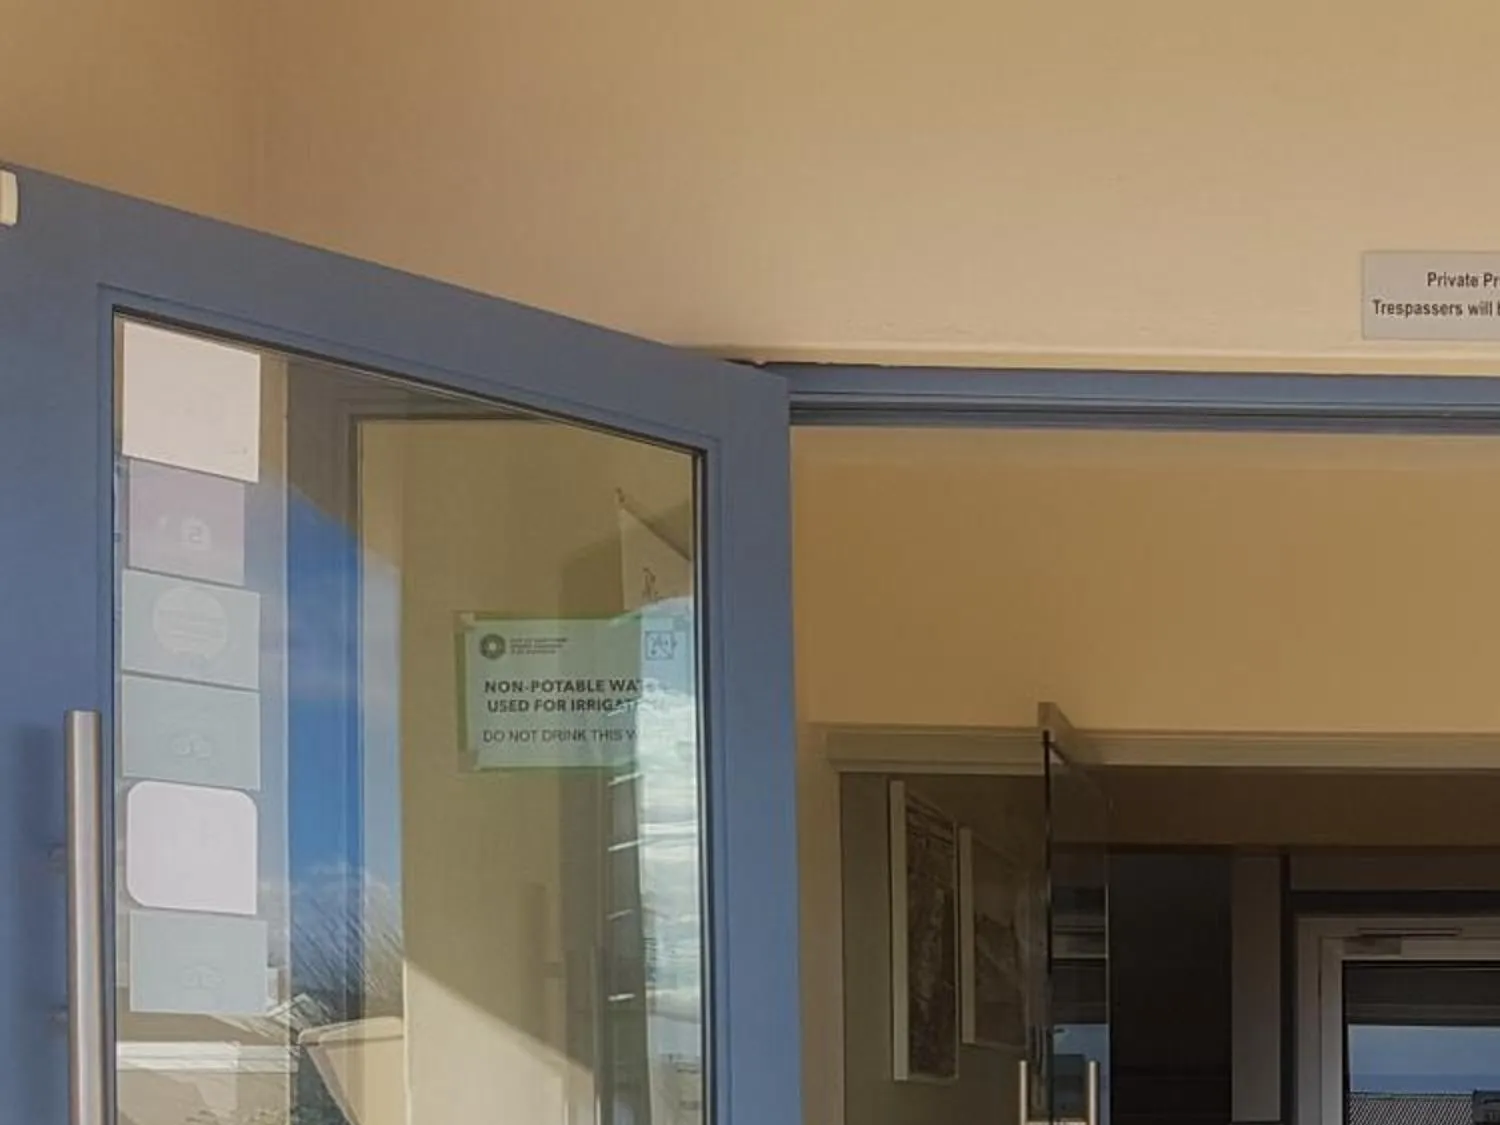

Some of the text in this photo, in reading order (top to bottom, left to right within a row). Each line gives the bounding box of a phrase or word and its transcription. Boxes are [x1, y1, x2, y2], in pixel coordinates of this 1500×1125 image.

[1426, 272, 1479, 288] Private
[1373, 299, 1463, 319] Trespassers
[1467, 301, 1493, 316] will
[484, 679, 605, 694] NON-POTABLE
[487, 699, 529, 713] USED
[534, 698, 566, 712] FOR
[483, 730, 505, 743] DO
[510, 729, 537, 743] NOT
[542, 729, 586, 742] DRINK
[590, 729, 623, 742] THIS
